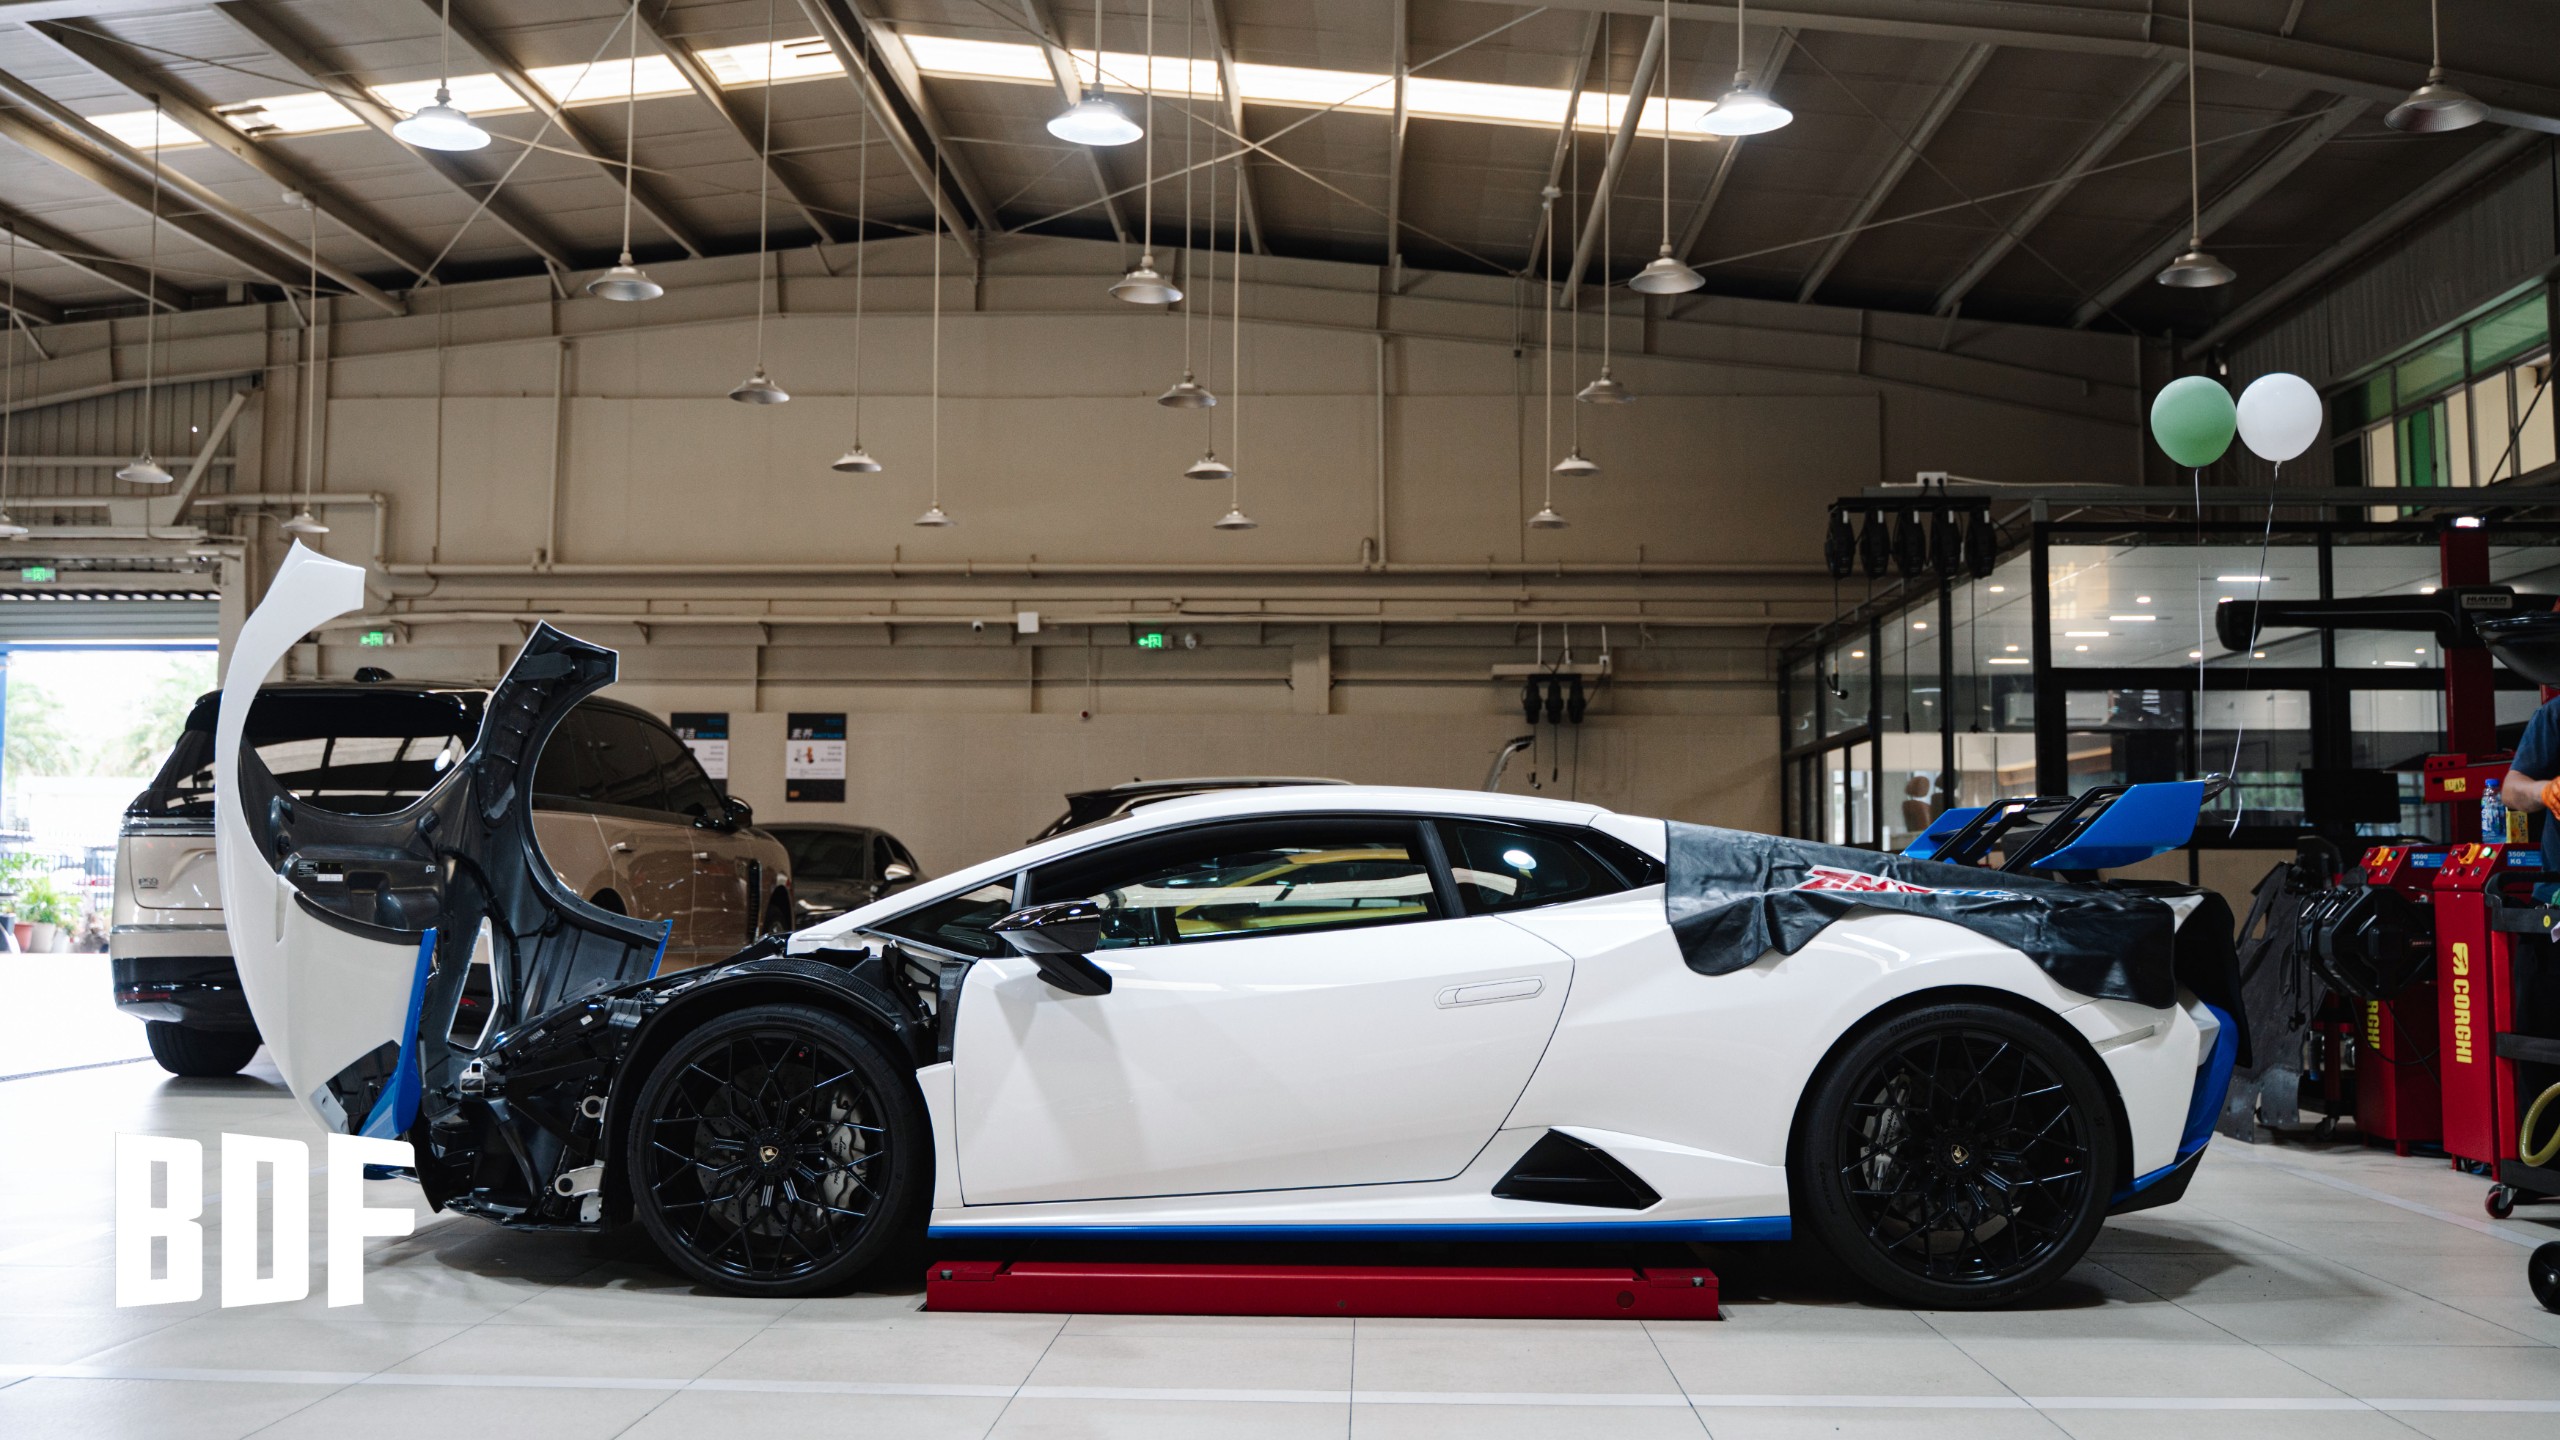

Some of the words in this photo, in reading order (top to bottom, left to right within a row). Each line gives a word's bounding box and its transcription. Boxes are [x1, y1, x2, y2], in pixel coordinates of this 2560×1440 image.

[1889, 1010, 1970, 1036] BRIDGESTONE
[2366, 1000, 2381, 1050] RGHI
[2453, 979, 2473, 1064] CORGHI
